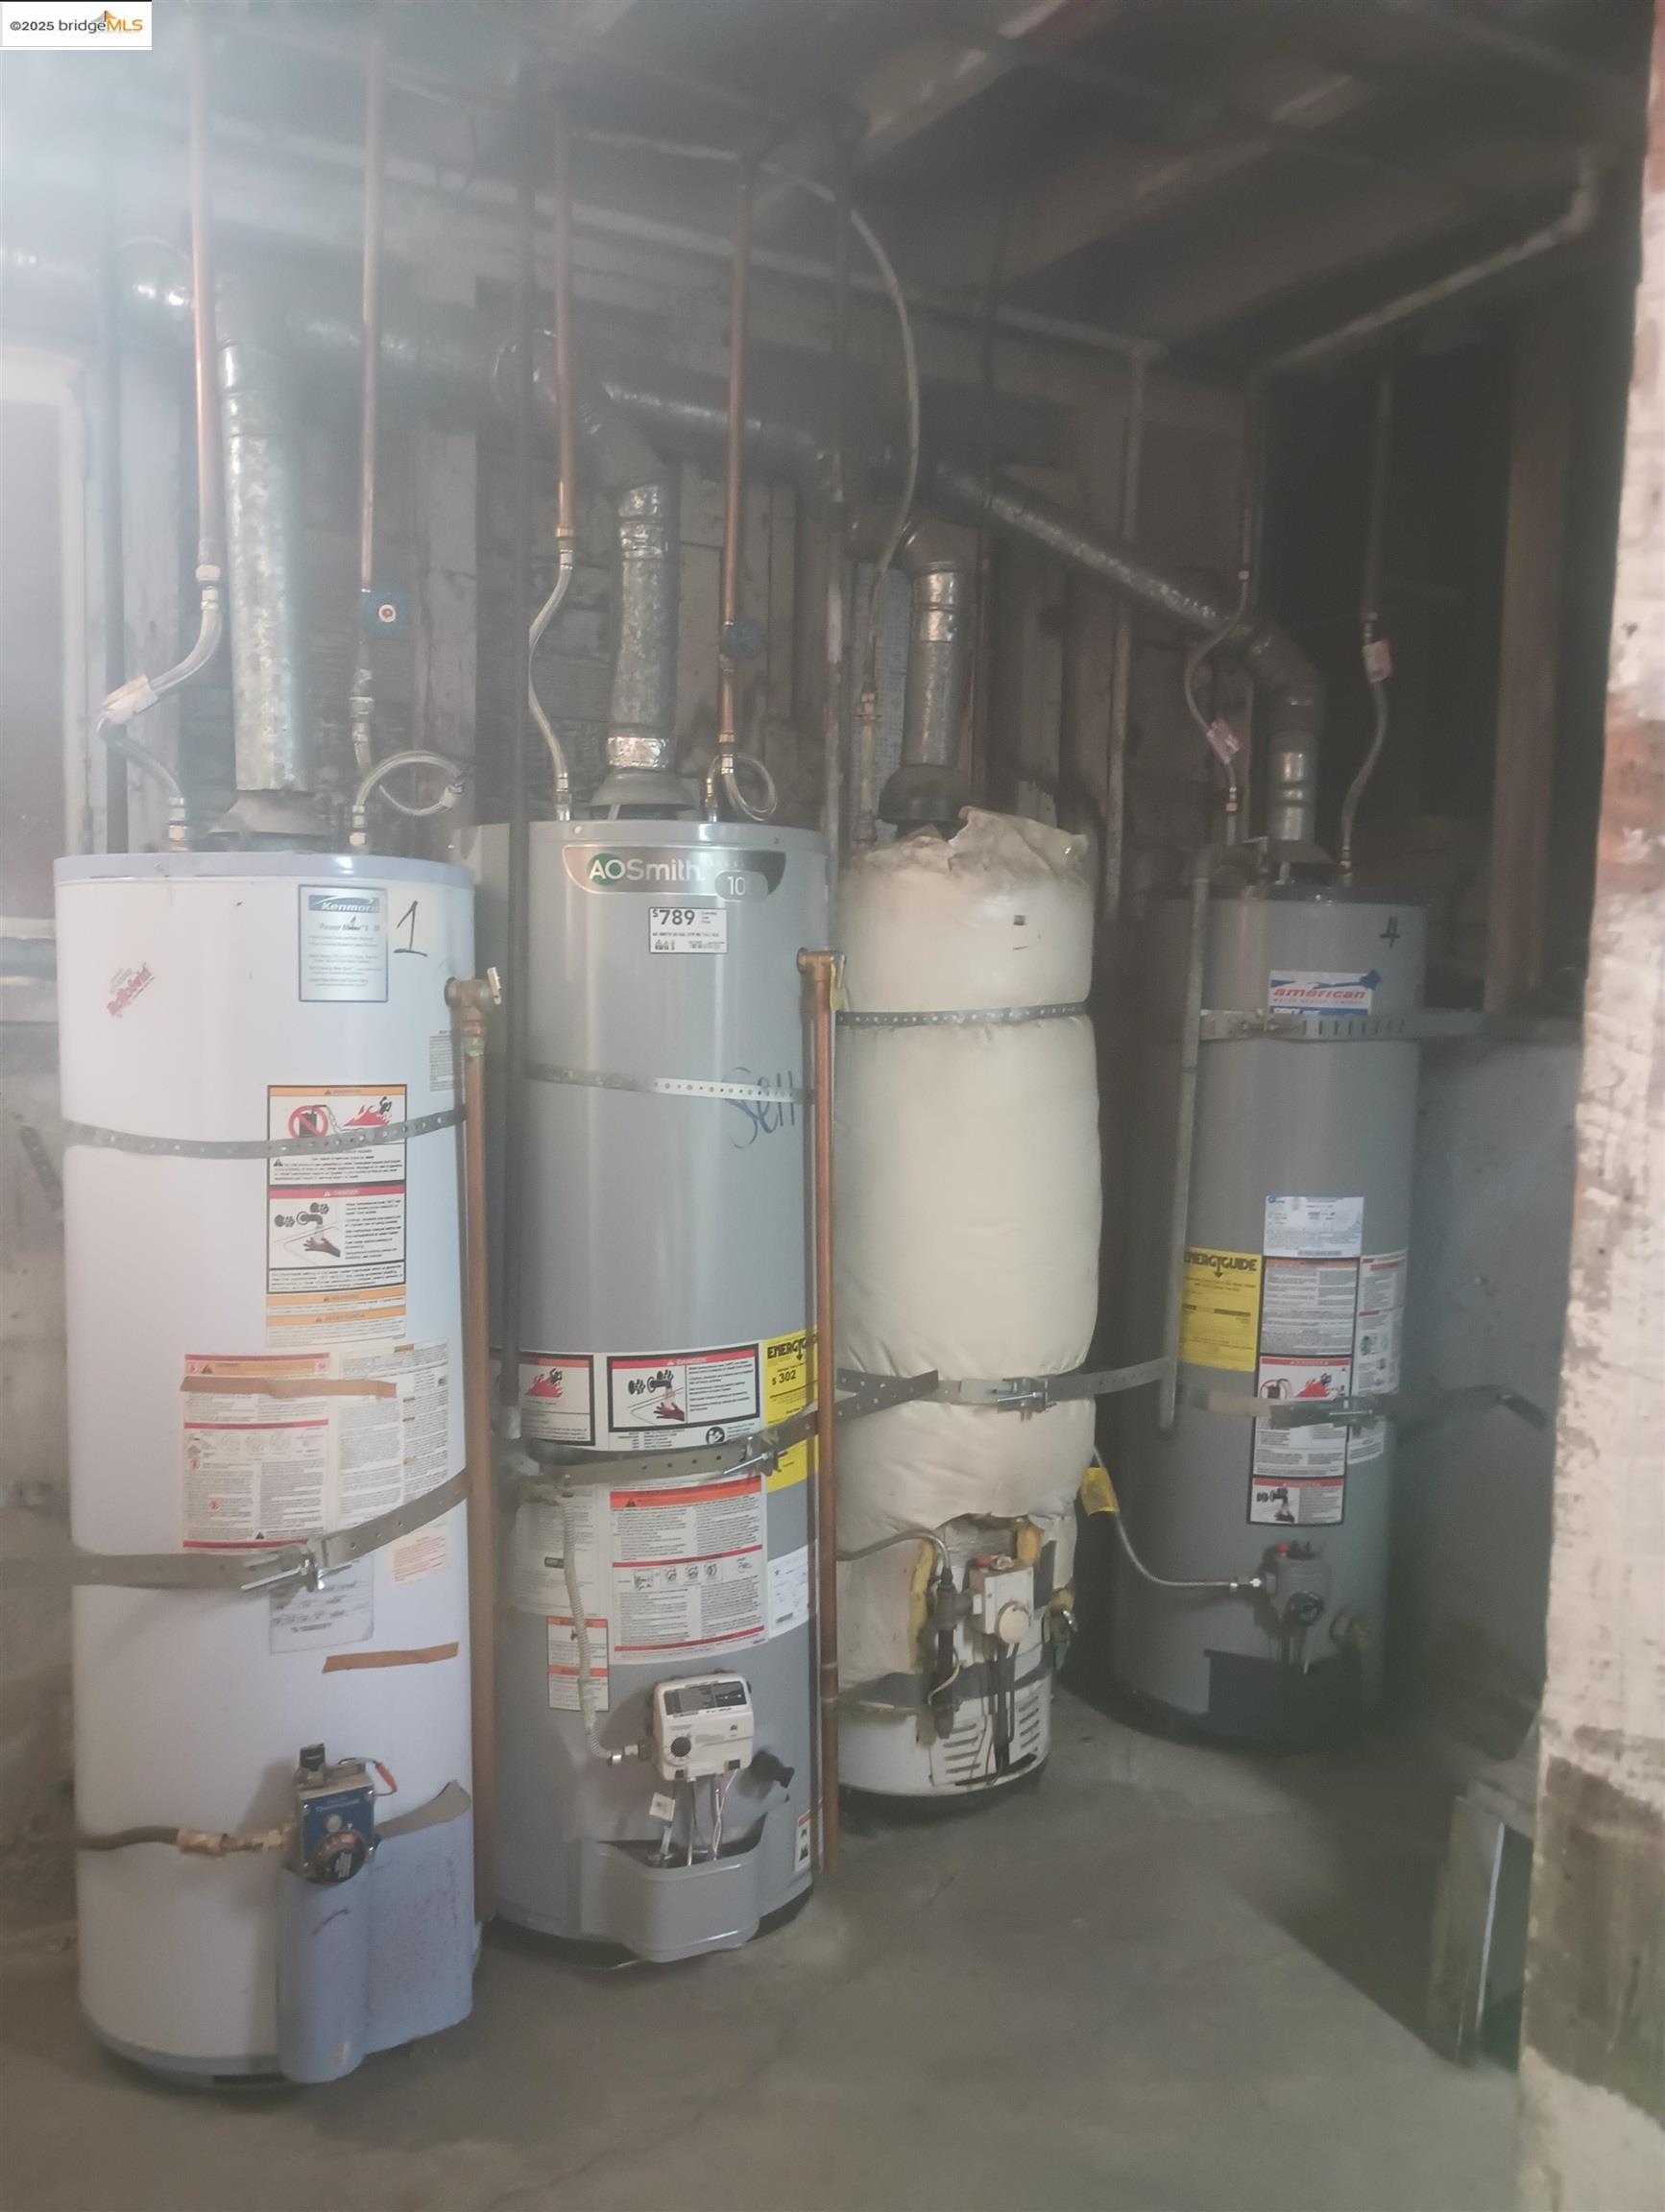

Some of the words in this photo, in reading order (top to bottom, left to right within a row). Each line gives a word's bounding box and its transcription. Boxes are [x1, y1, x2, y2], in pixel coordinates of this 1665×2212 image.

[727, 876, 746, 896] 10
[320, 902, 379, 913] Kenmore
[652, 908, 695, 926] $789
[393, 900, 428, 957] 1
[1380, 915, 1401, 949] 4
[1273, 988, 1366, 999] american
[779, 1370, 796, 1383] 302
